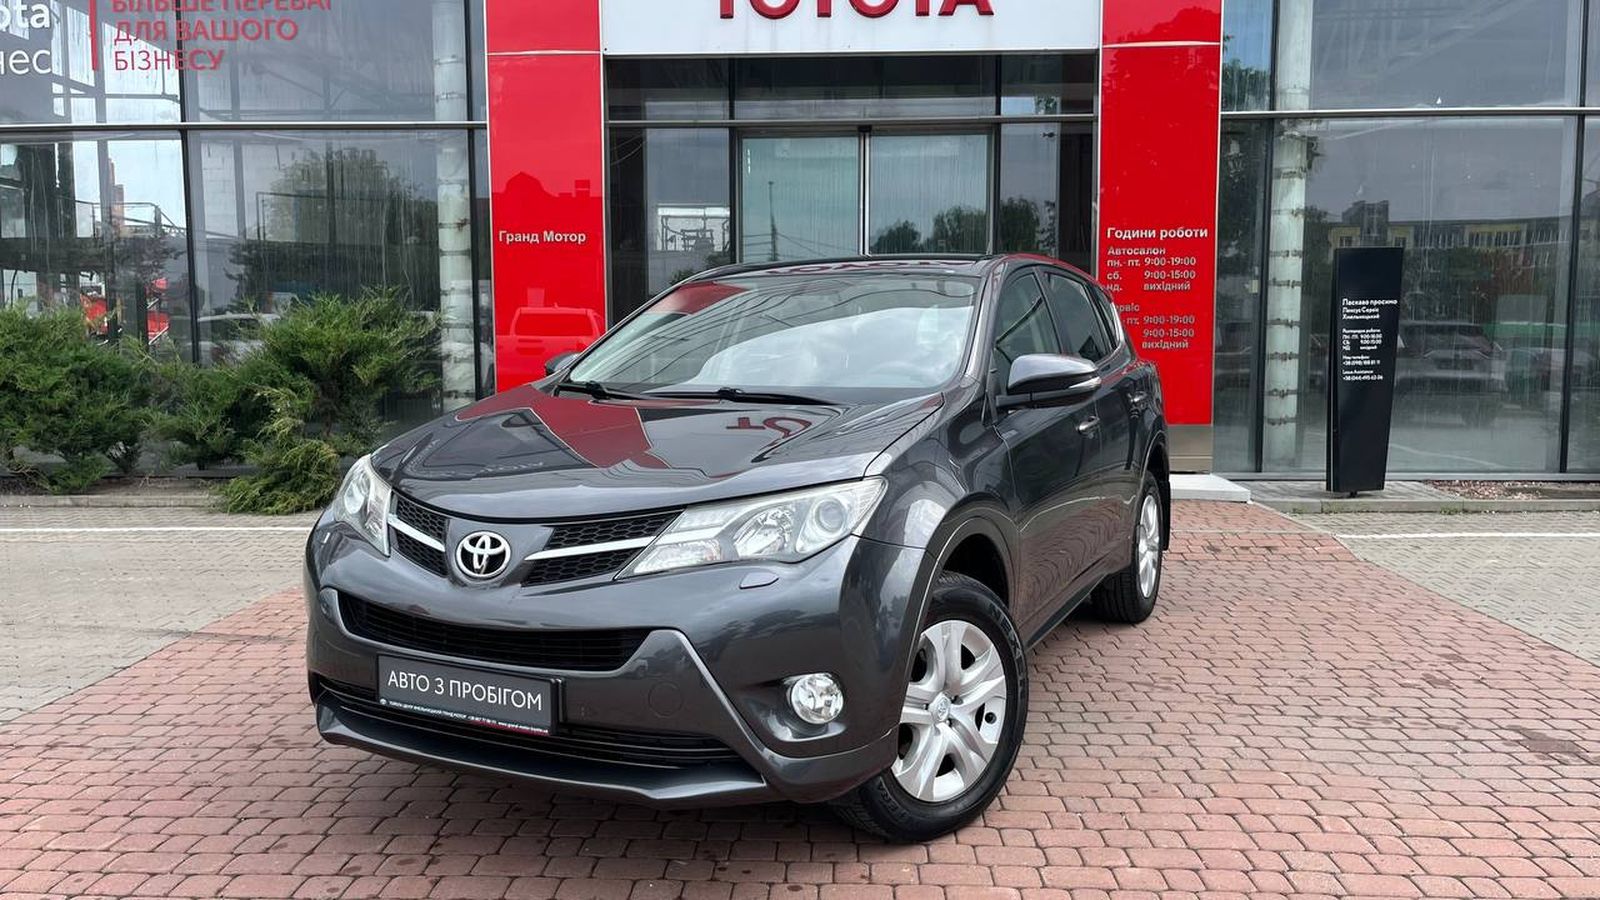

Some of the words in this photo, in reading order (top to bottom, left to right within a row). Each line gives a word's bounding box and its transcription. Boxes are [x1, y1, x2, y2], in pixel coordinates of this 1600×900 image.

[114, 19, 166, 46] ДЛЯ
[176, 18, 299, 41] ВАШОГО
[114, 48, 225, 71] БІЗНЕСУ
[499, 230, 540, 245] Гранд
[543, 230, 587, 245] Мотор
[1107, 227, 1156, 240] Години
[1160, 226, 1208, 240] роботи
[1107, 246, 1166, 256] Автосалон
[1106, 271, 1122, 280] сб.
[1143, 281, 1191, 292] вихідний
[1142, 340, 1189, 350] вихідний
[387, 670, 430, 692] АВТО
[434, 677, 445, 695] З
[449, 679, 543, 711] ПРОБІГОМ
